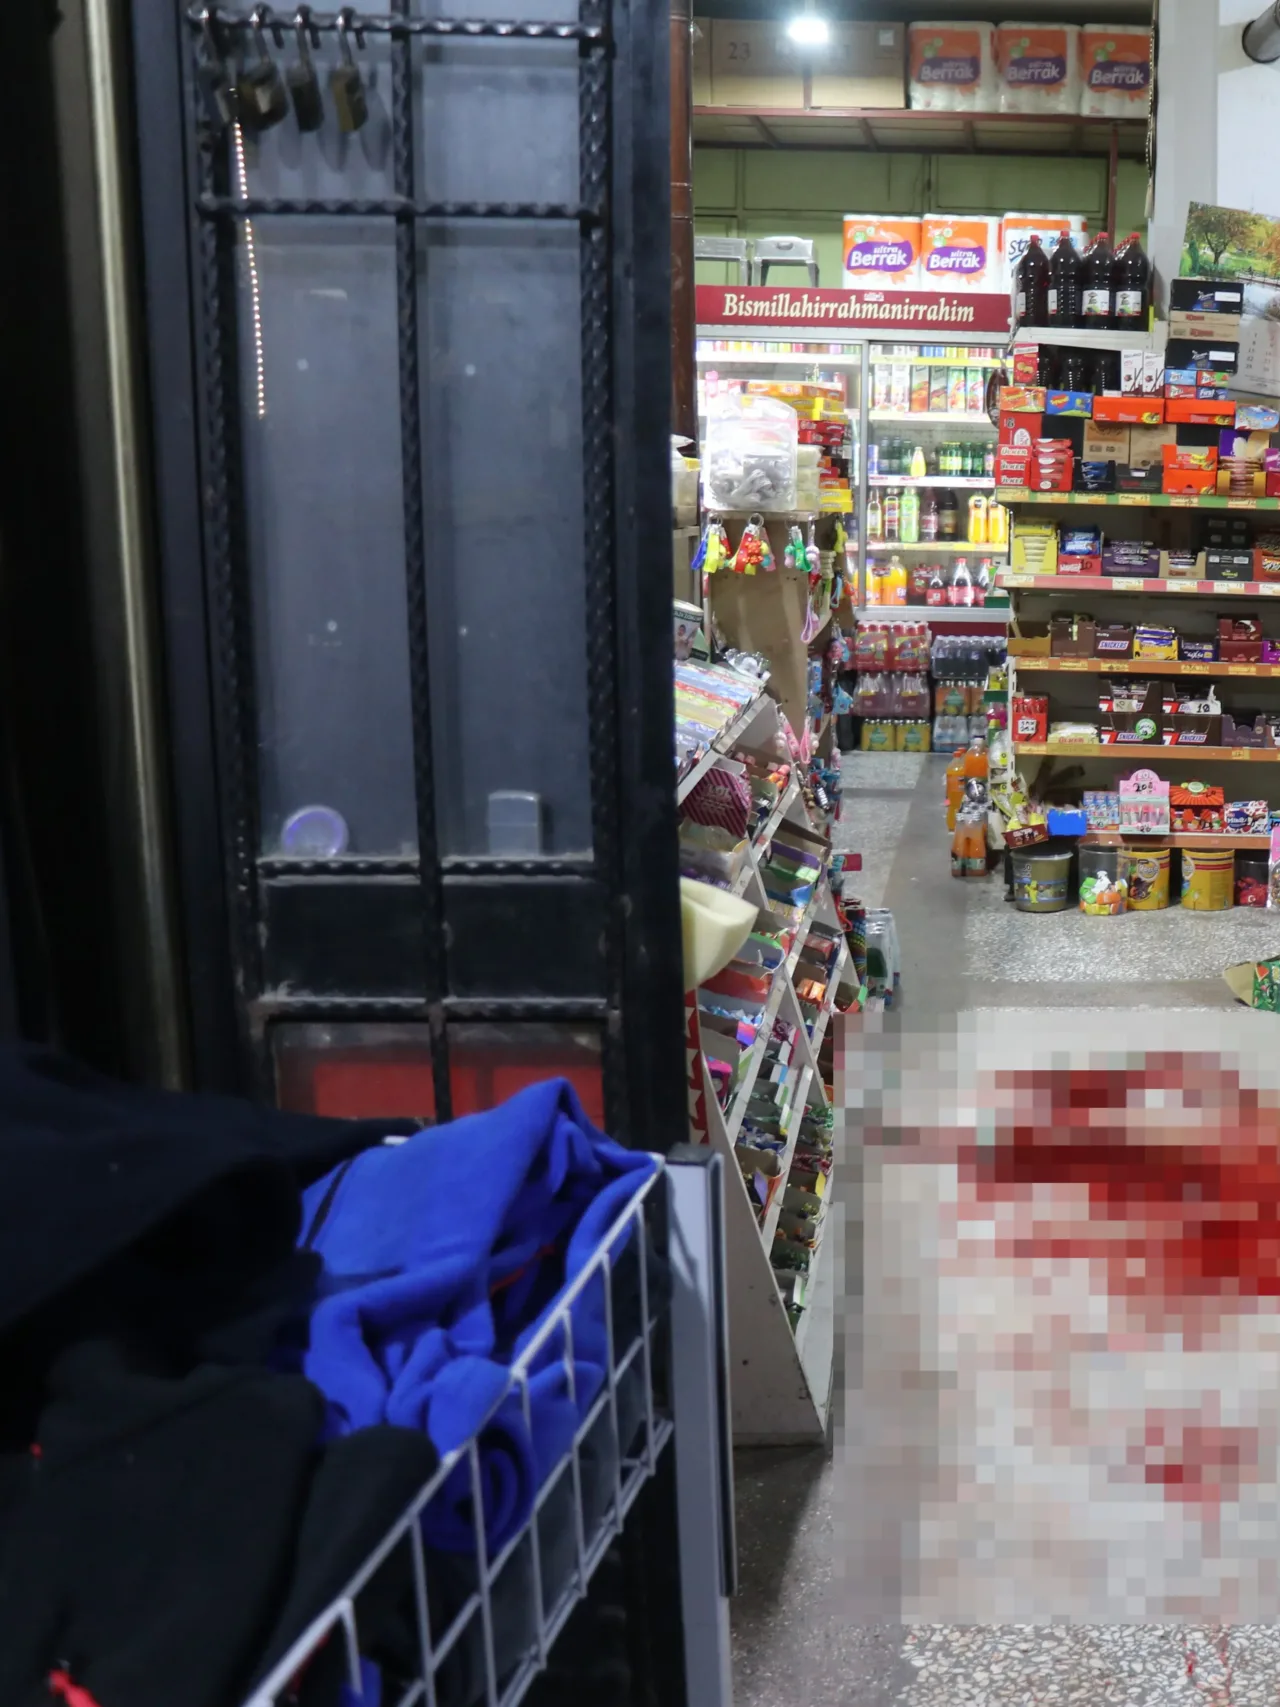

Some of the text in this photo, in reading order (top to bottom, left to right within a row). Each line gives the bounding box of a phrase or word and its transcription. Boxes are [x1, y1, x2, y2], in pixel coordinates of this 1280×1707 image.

[921, 64, 973, 80] Berrak
[1008, 63, 1060, 80] Berrak
[1091, 69, 1144, 85] Berrak
[873, 244, 898, 254] ultra
[951, 249, 972, 258] ultra
[850, 249, 907, 267] Berrak
[929, 252, 980, 269] Berrak
[722, 293, 975, 322] Bismillahirrahmanirrahim
[1100, 641, 1128, 649] SNICKERS
